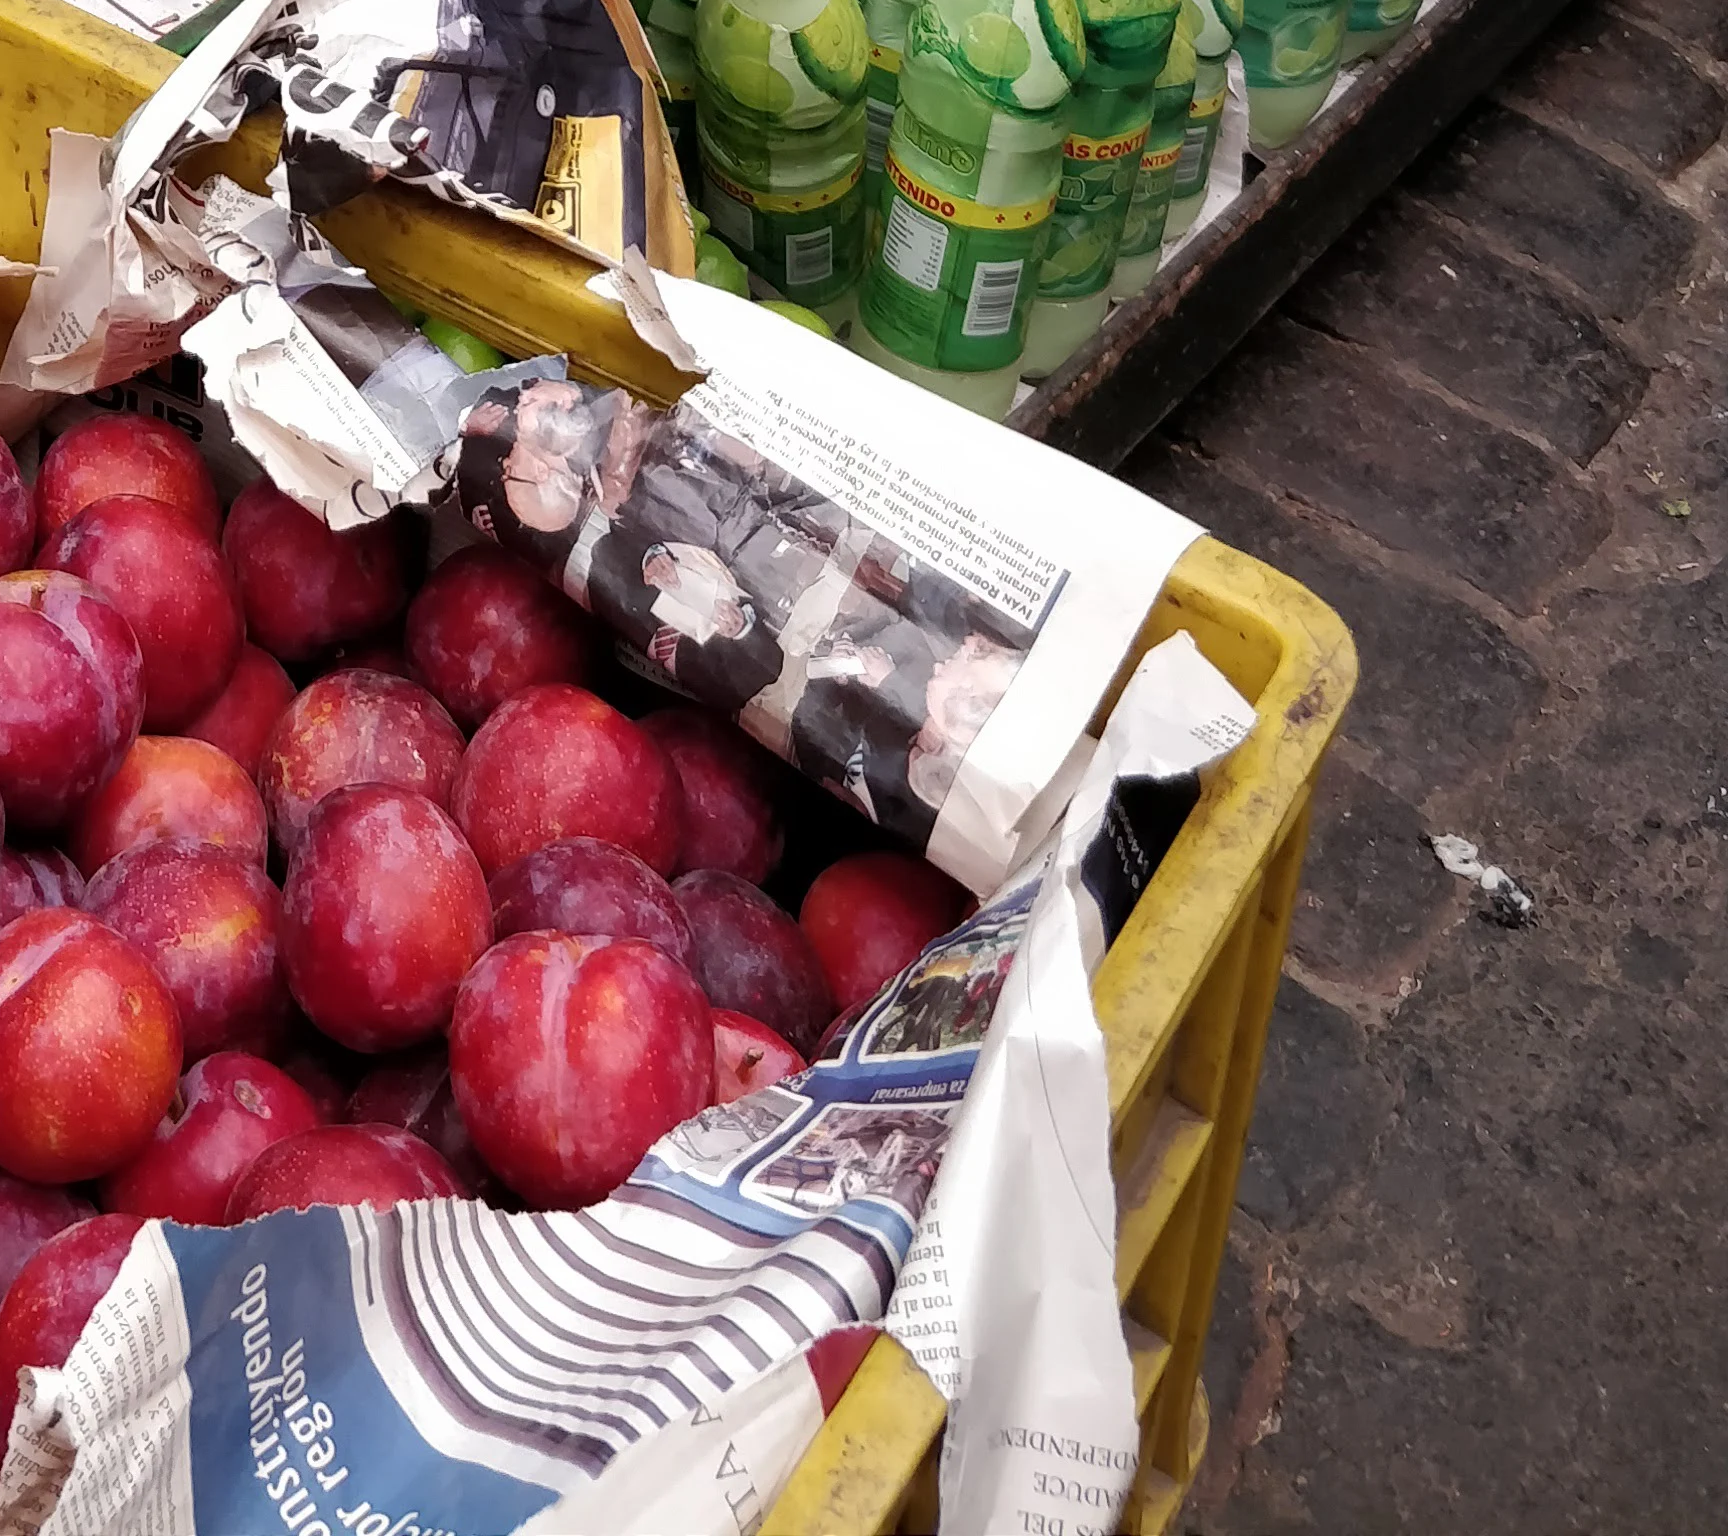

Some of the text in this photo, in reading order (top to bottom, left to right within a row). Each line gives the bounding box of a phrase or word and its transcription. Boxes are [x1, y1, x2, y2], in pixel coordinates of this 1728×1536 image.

[788, 420, 837, 455] proceso
[810, 453, 866, 492] Congreso
[832, 447, 857, 470] del
[854, 460, 888, 488] tanto
[879, 495, 916, 525] visita
[885, 480, 958, 530] promotores
[909, 476, 978, 523] aprobación
[915, 518, 972, 561] polémica
[955, 523, 1050, 590] parlamentarios
[986, 525, 1034, 561] trámite
[941, 554, 1001, 600] ROBERTO
[1033, 554, 1057, 576] del
[997, 591, 1034, 623] IVÁN
[90, 1311, 117, 1346] que
[278, 1337, 349, 1493] región
